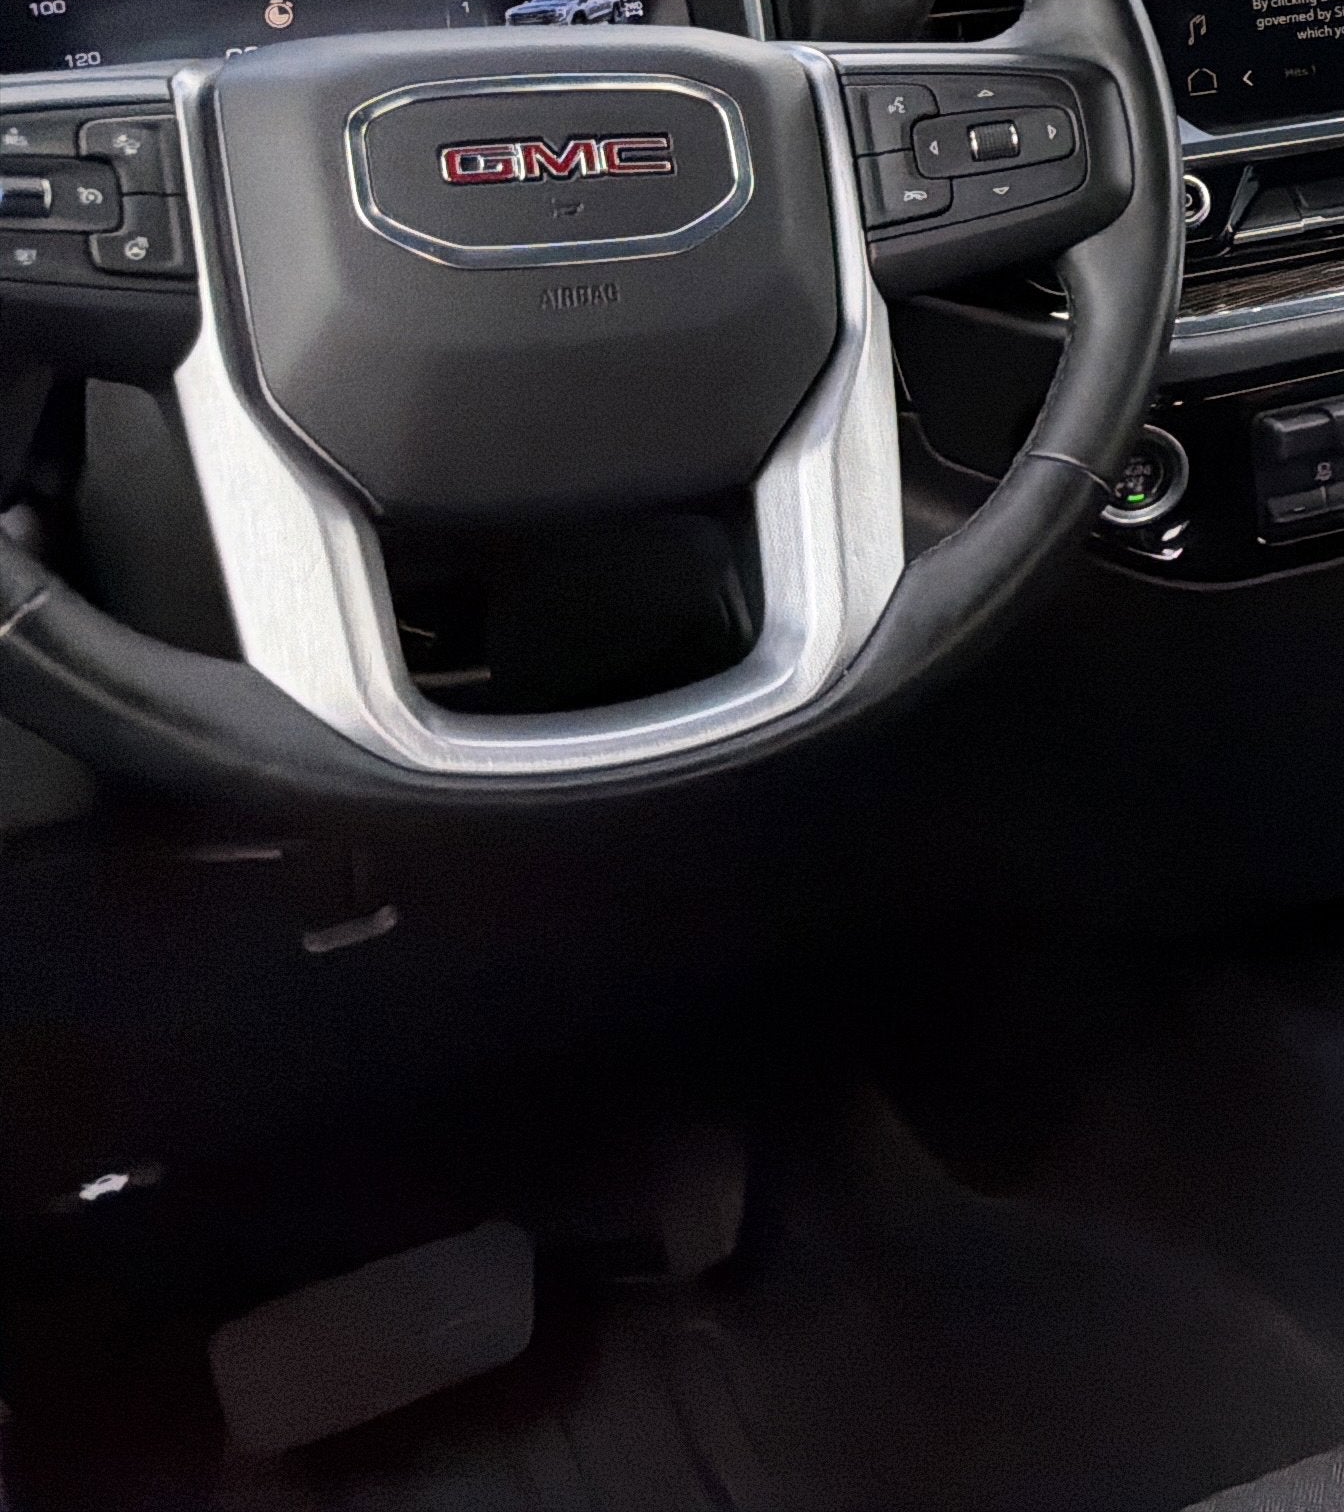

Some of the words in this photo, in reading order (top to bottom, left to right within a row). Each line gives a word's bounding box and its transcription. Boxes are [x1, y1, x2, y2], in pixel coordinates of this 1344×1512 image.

[29, 0, 66, 16] 100
[461, 1, 470, 13] 1
[1256, 9, 1315, 31] governed
[1317, 7, 1332, 22] by
[1296, 25, 1333, 40] which
[65, 51, 101, 68] 120
[440, 137, 673, 182] GMC
